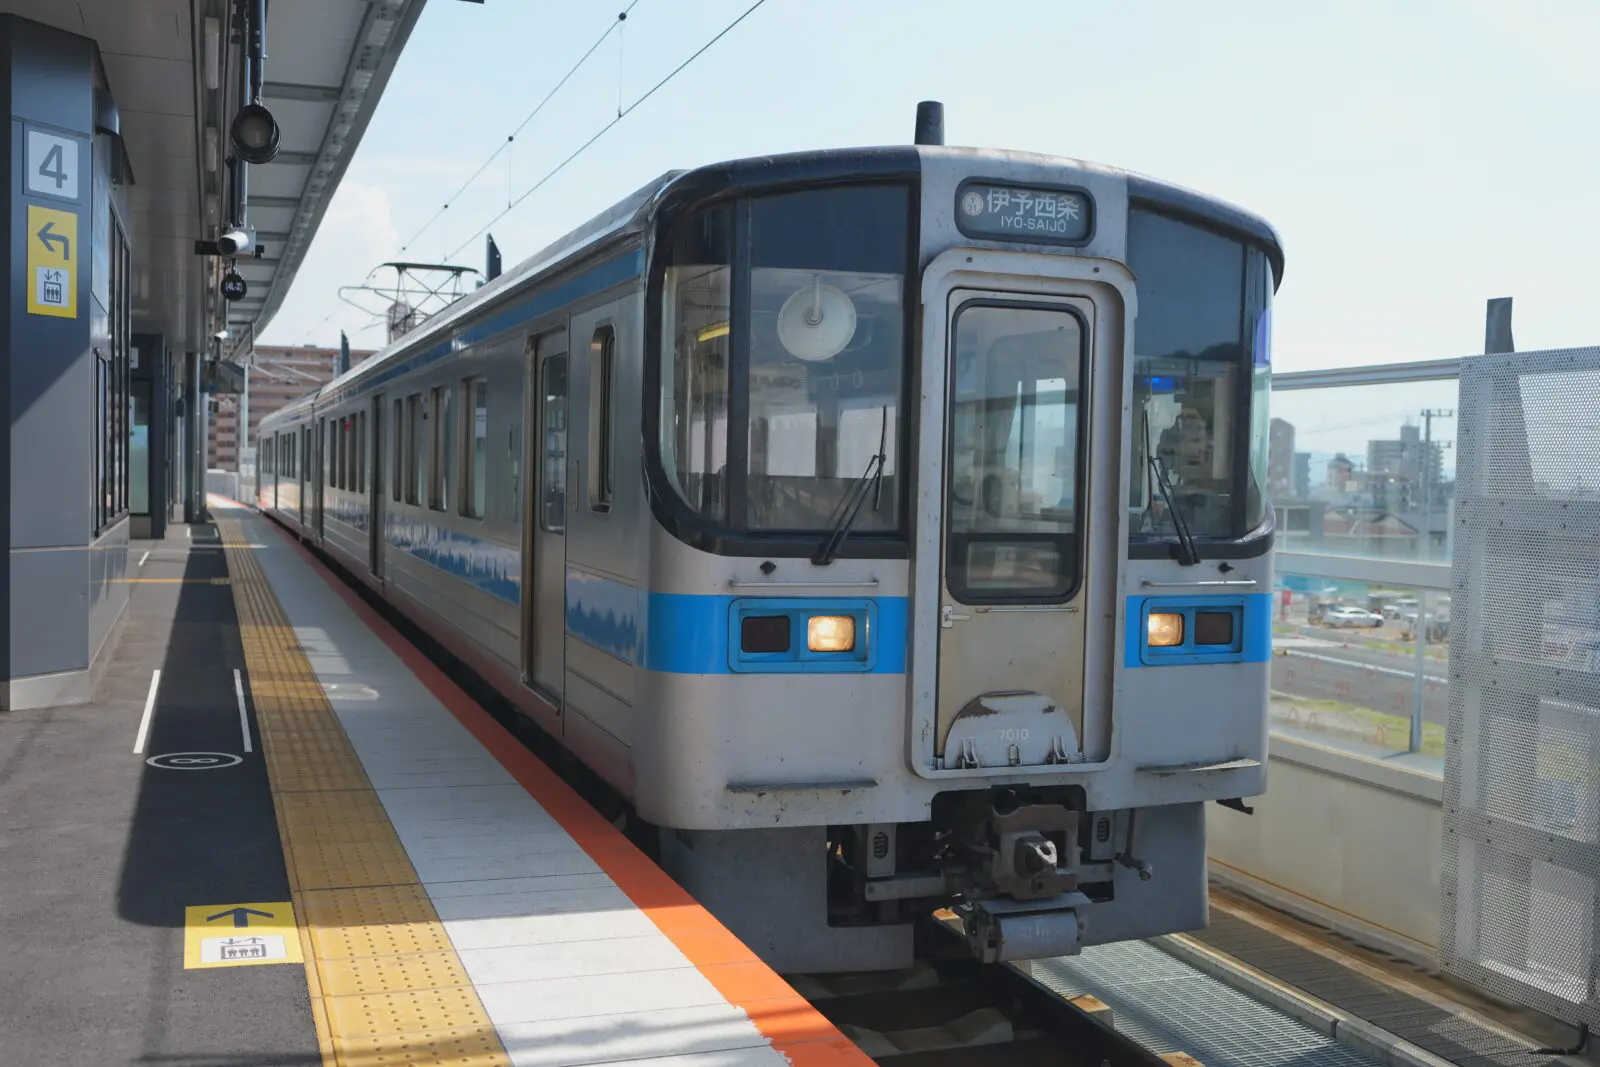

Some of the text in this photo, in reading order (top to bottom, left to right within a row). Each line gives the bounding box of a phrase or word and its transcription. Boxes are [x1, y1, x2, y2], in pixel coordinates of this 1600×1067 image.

[39, 144, 68, 189] 4
[987, 188, 1080, 220] 伊予西条
[998, 728, 1029, 741] 7010
